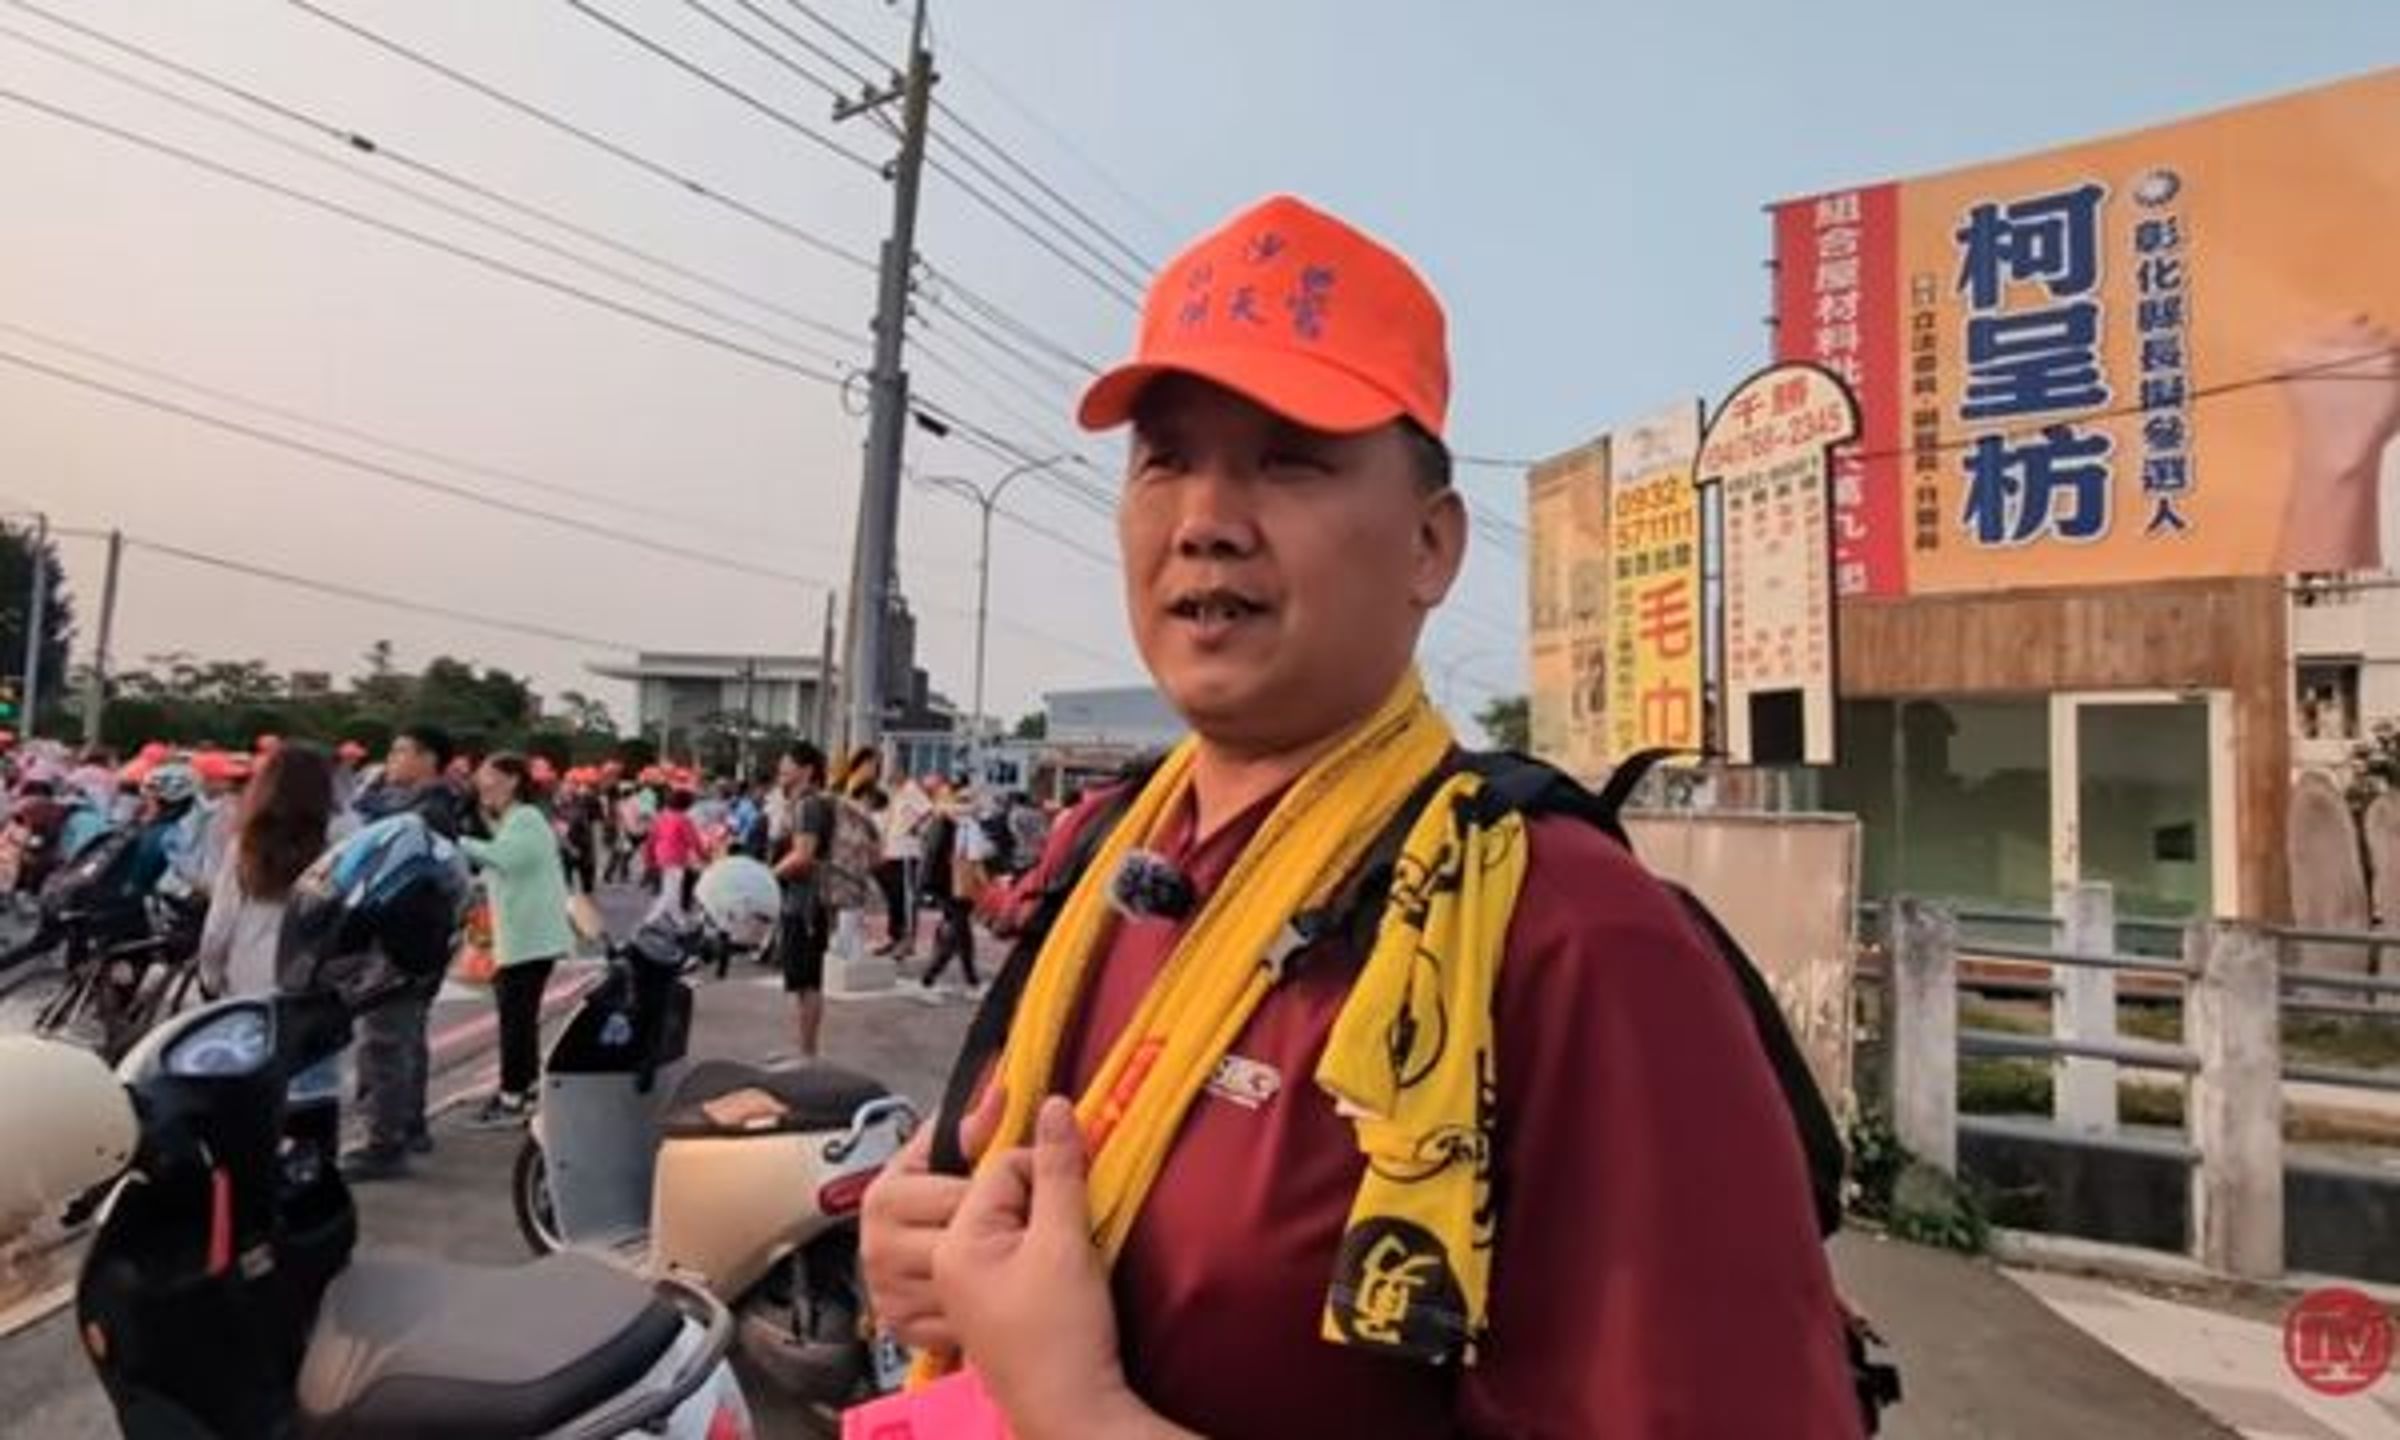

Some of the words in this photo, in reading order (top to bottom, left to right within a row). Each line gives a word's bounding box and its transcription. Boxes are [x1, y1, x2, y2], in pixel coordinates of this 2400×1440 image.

[1954, 183, 2111, 545] 柯呈枋
[1639, 578, 1692, 748] 毛巾
